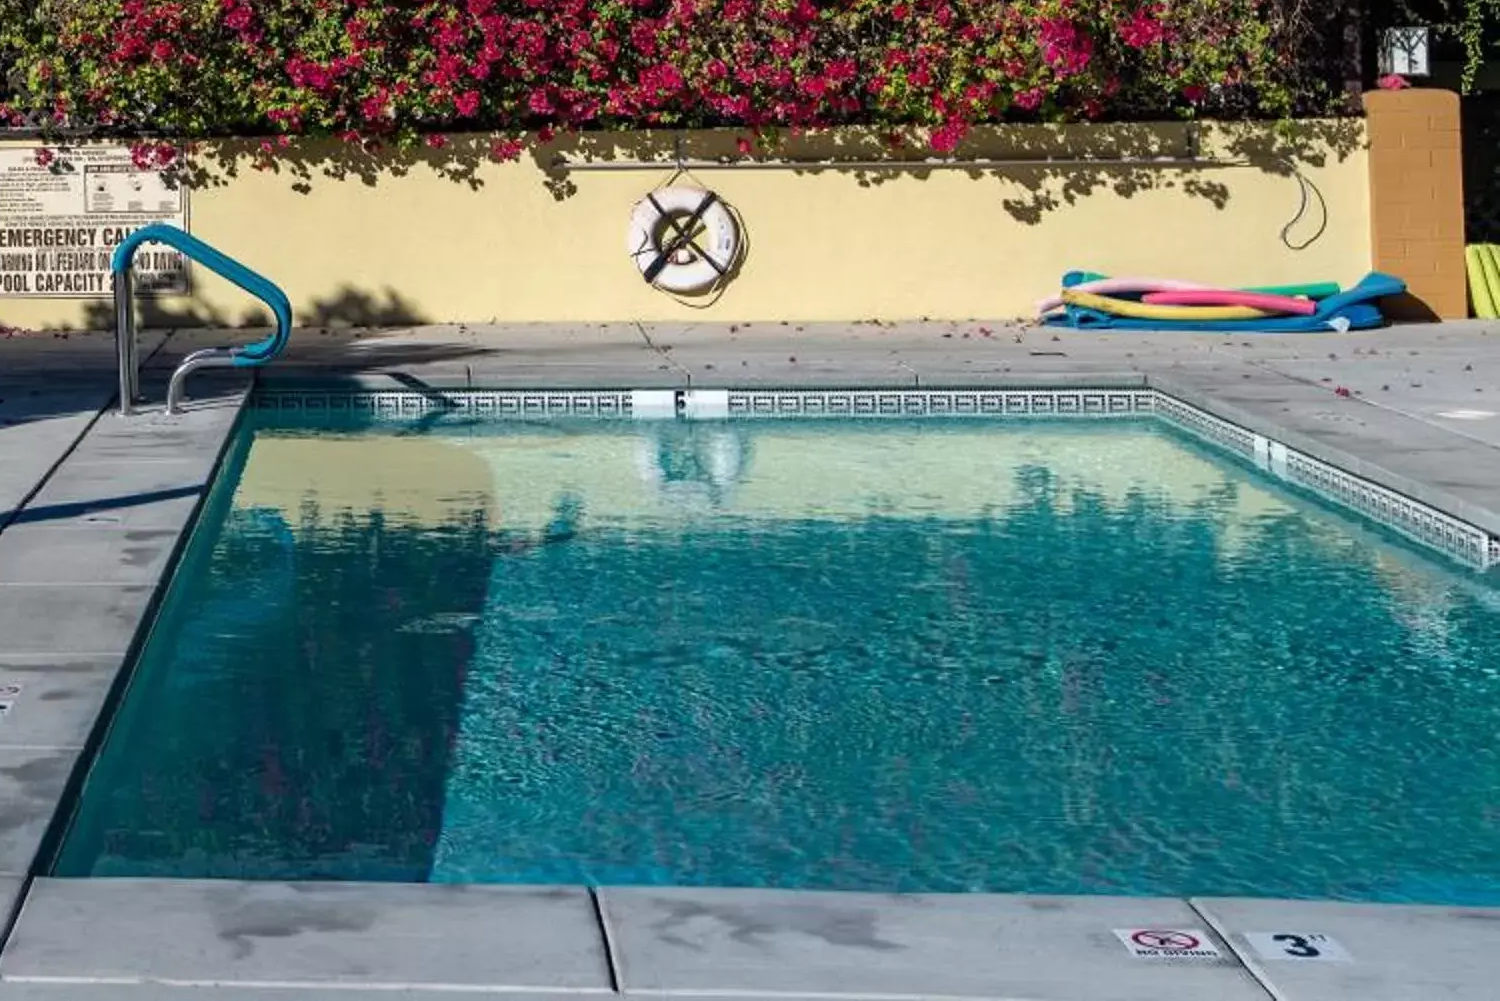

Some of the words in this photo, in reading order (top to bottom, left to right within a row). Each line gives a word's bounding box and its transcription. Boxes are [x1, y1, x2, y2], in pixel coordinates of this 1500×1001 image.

[103, 228, 140, 247] CAL
[35, 253, 47, 271] NO
[50, 253, 95, 271] LIFEGUARD
[35, 273, 104, 292] CAPACITY
[1272, 934, 1321, 957] 3
